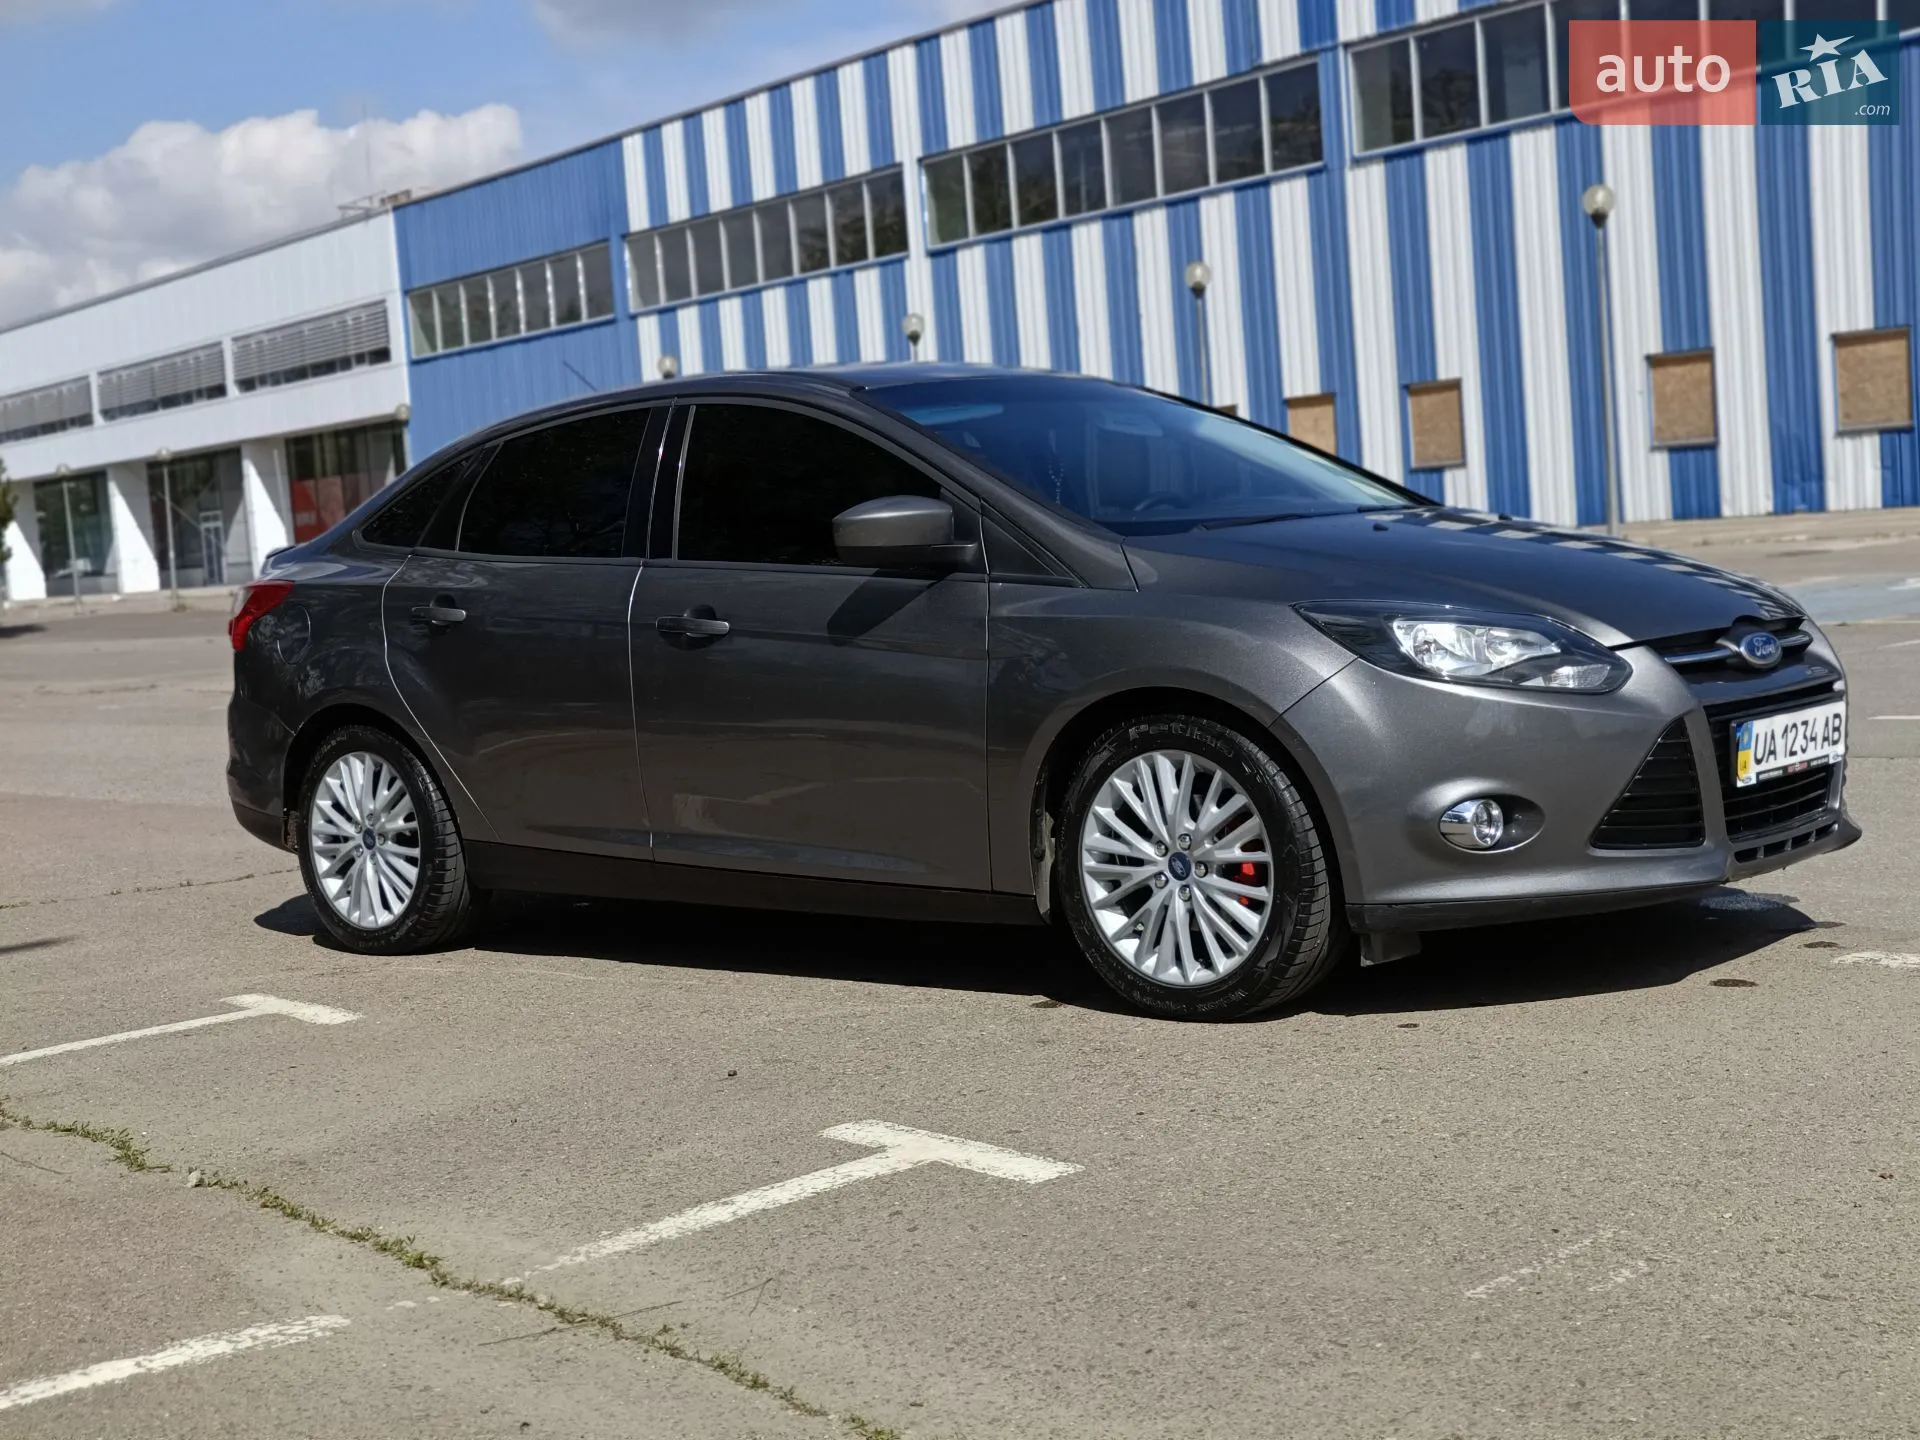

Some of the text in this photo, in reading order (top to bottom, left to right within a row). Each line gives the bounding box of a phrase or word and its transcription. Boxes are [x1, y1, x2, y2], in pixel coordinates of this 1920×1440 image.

[1754, 713, 1842, 765] UA 1234 AB
